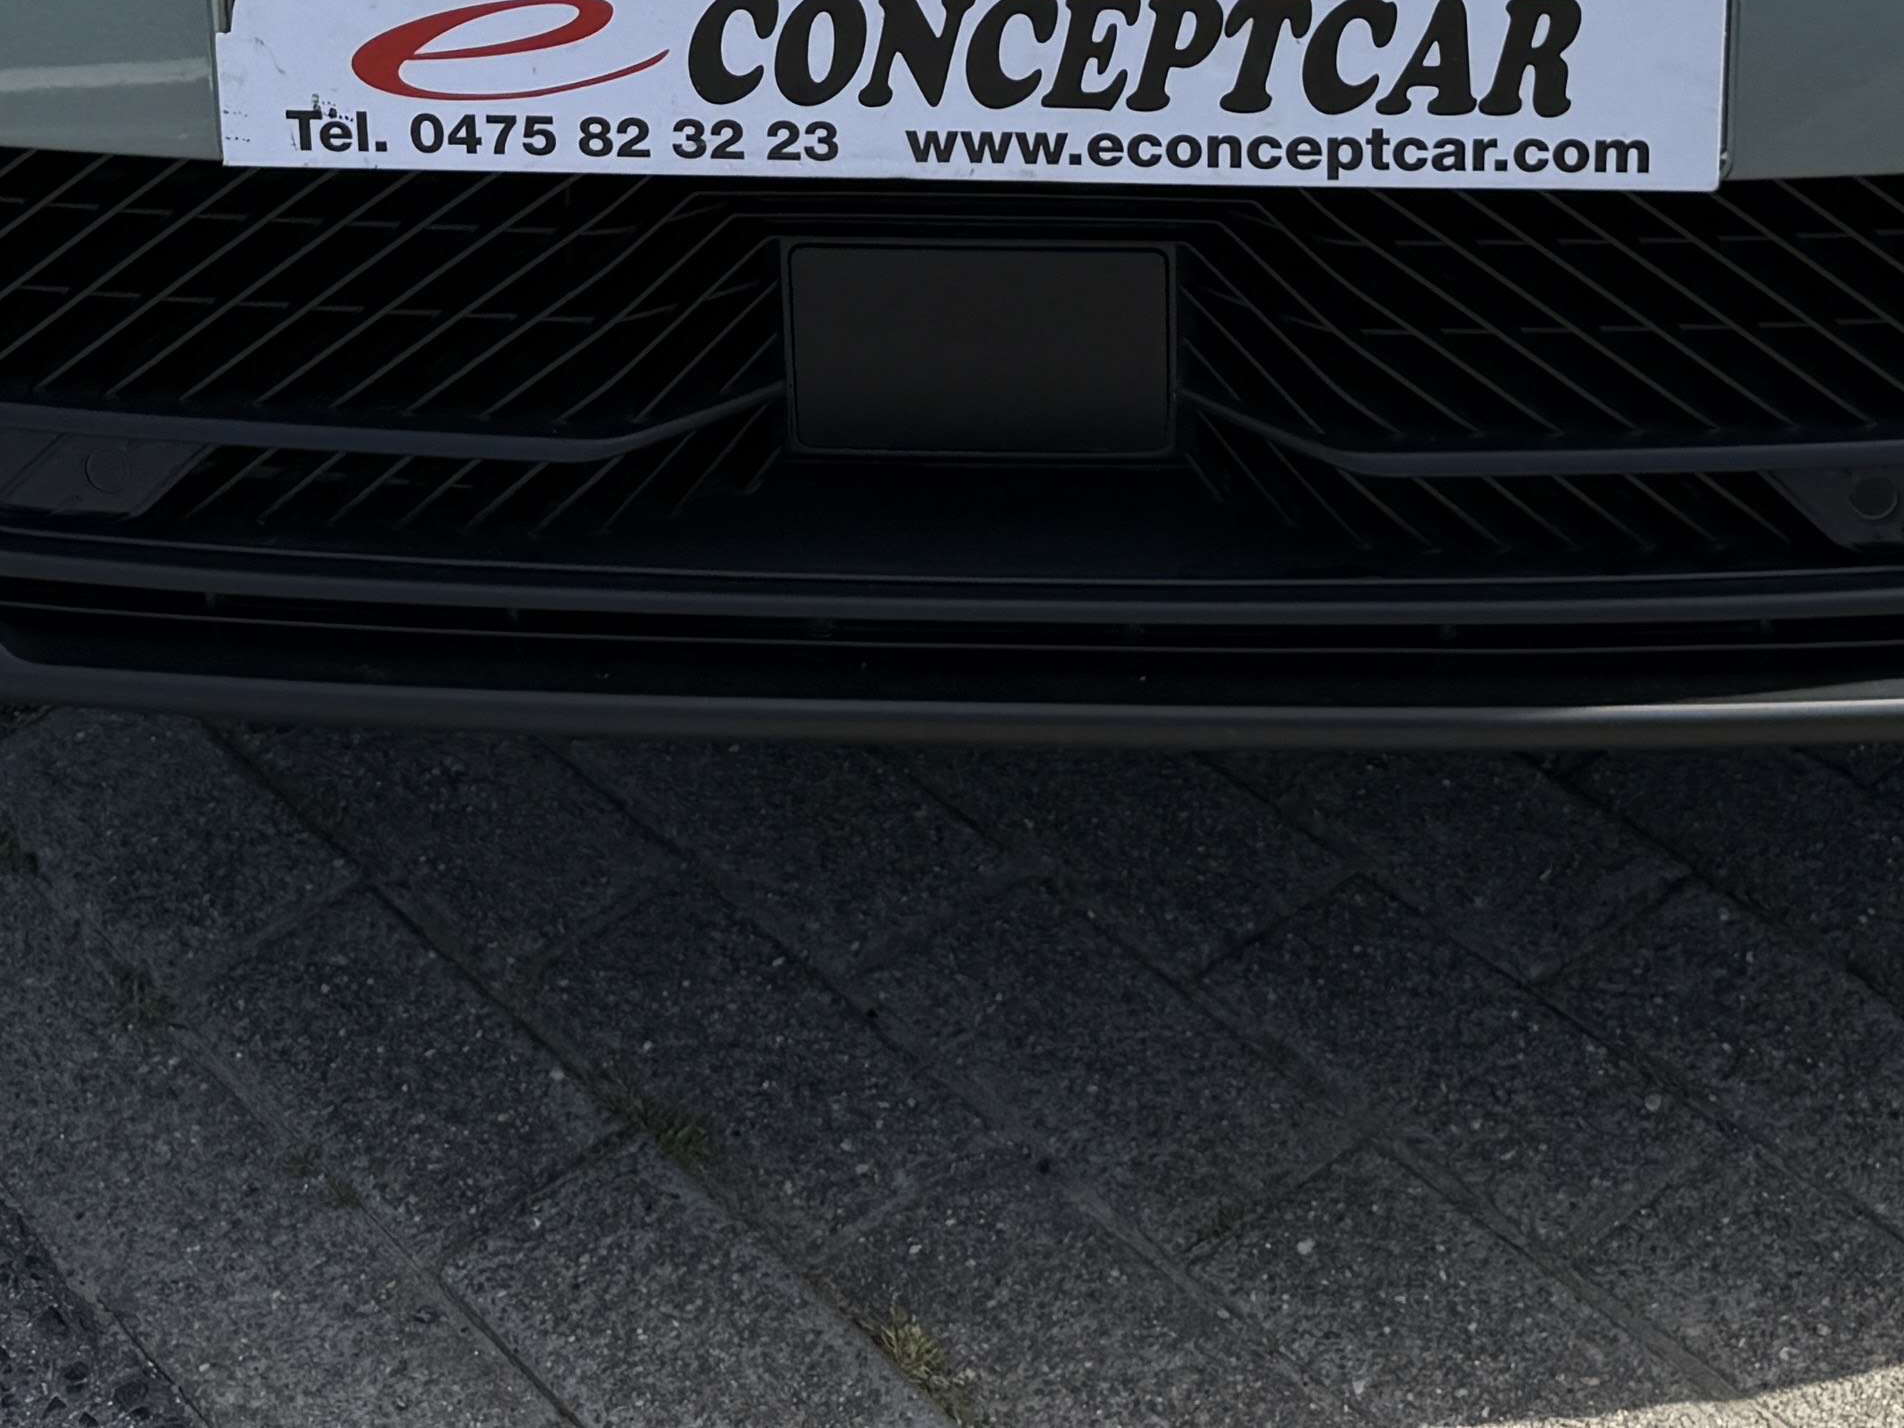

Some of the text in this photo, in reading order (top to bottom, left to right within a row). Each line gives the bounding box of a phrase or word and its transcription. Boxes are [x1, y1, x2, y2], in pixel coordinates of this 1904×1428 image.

[285, 109, 1651, 181] Tel. 0475 82 32 23 www.econceptcar.com
